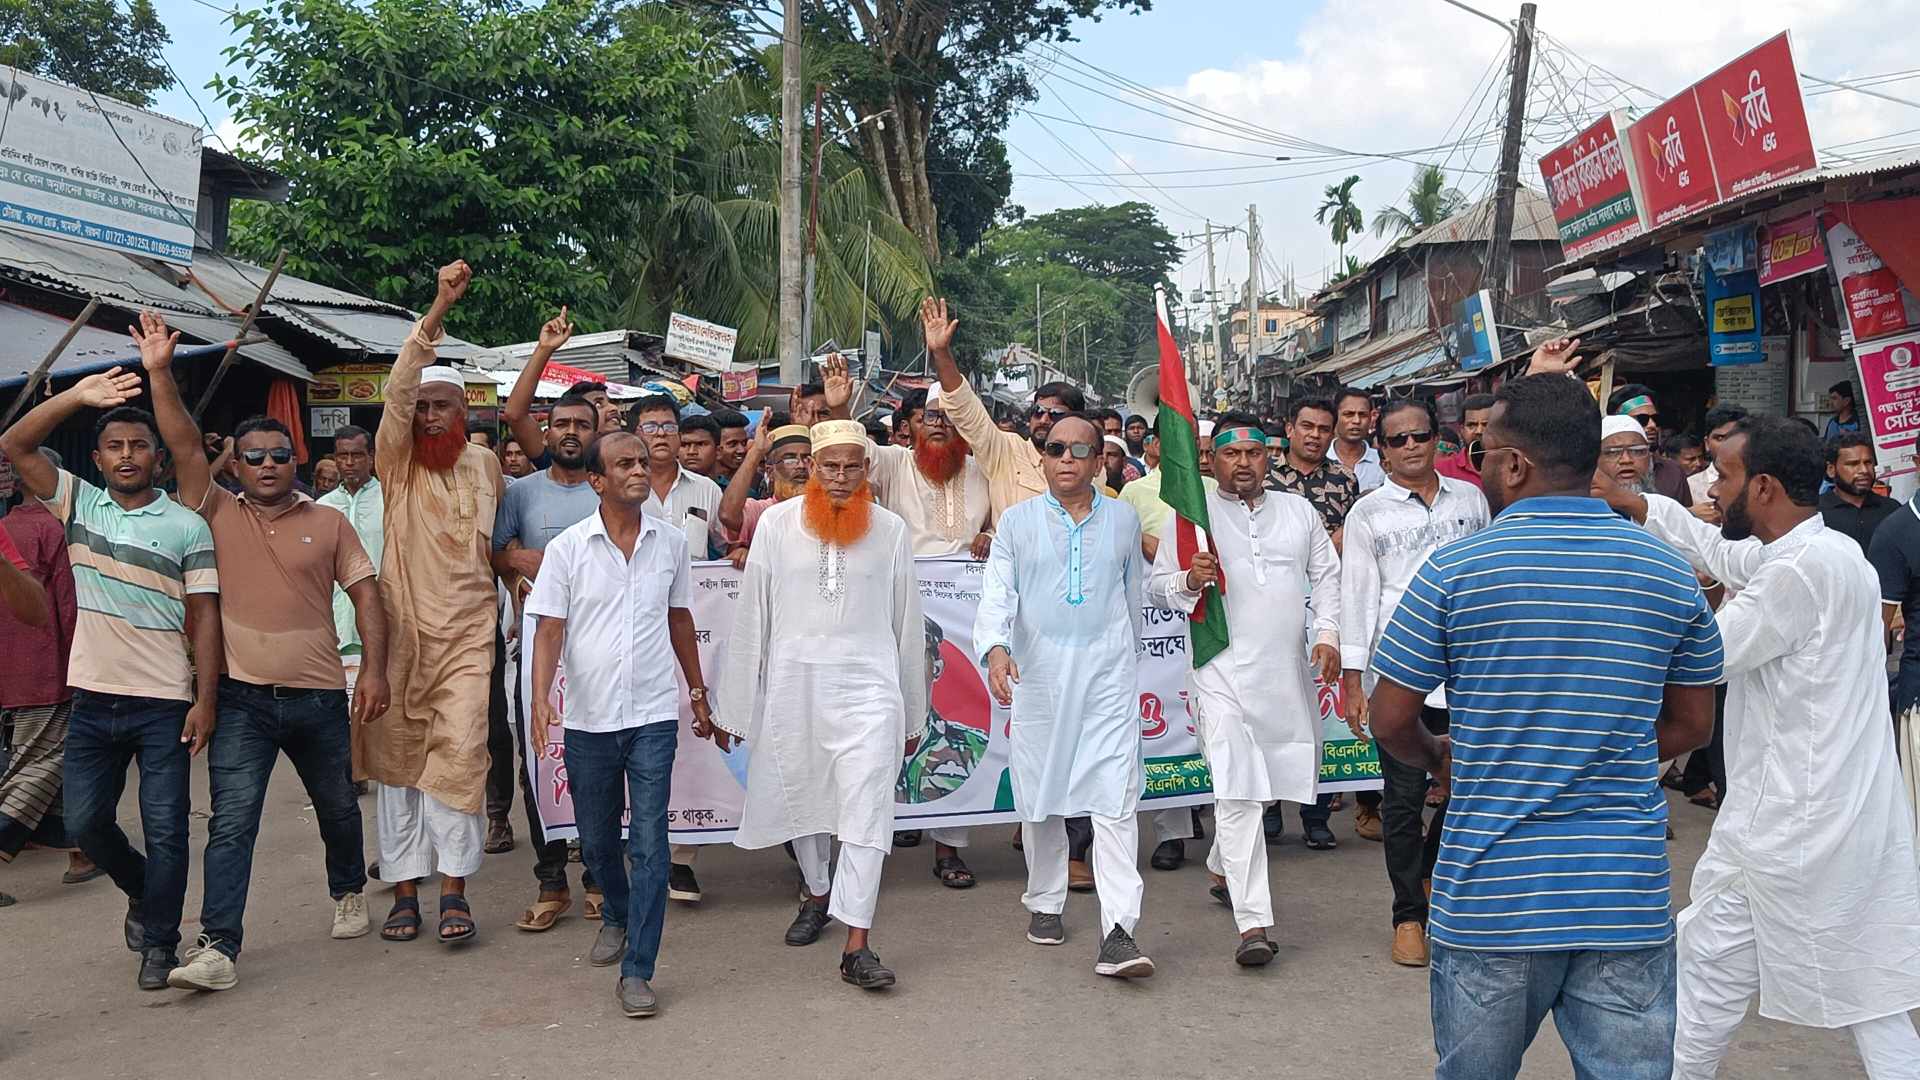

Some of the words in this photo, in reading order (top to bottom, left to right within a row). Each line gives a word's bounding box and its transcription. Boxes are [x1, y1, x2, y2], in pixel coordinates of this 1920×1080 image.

[1741, 69, 1772, 137] রবি
[1662, 116, 1685, 174] রবি
[1324, 740, 1371, 760] বিএনপি
[1341, 762, 1353, 775] ও
[1190, 775, 1200, 788] ও
